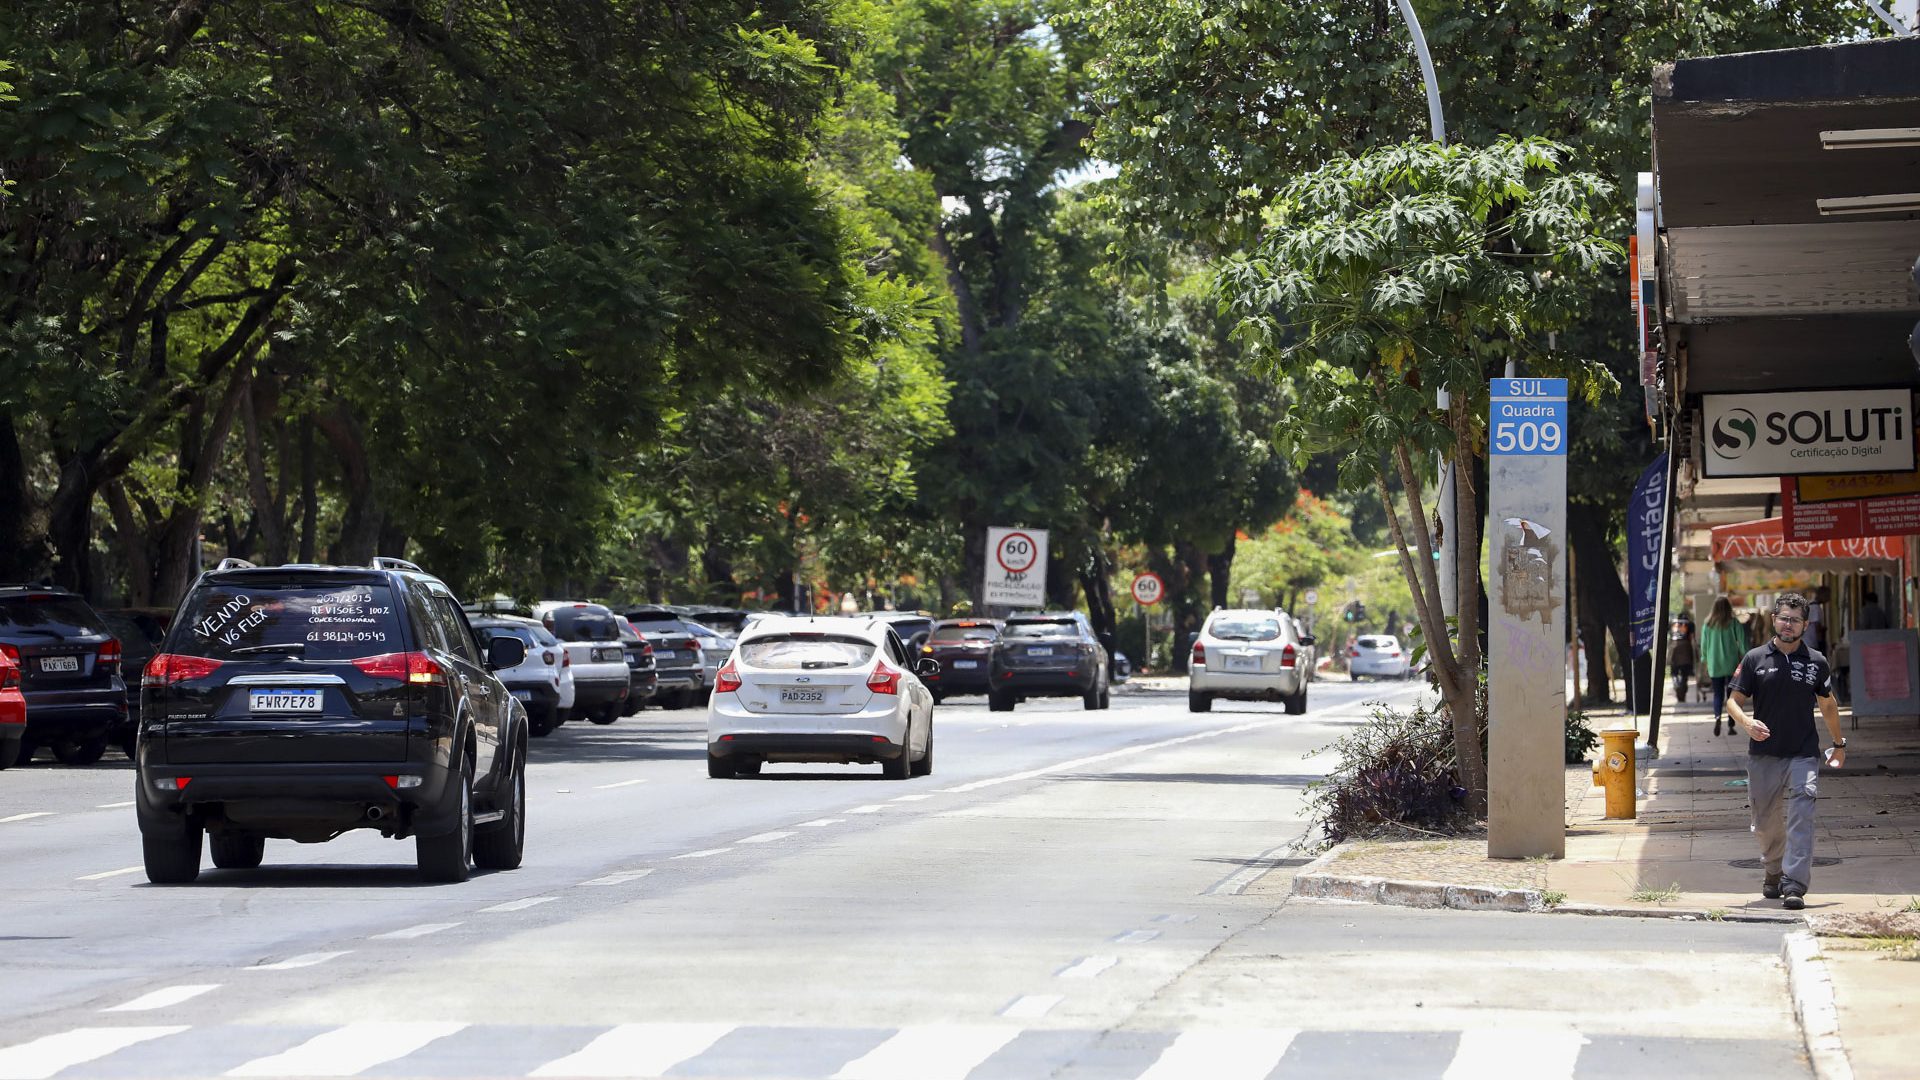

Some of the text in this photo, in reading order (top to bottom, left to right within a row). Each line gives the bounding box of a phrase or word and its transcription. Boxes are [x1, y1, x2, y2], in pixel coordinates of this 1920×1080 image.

[1509, 380, 1547, 396] SUL
[1501, 404, 1555, 417] Quadra
[1495, 422, 1561, 452] 509
[1790, 446, 1882, 459] Certificação Digital
[1006, 541, 1028, 555] 60
[1138, 579, 1156, 592] 60
[193, 594, 250, 637] VENDO
[219, 608, 268, 646] V6 FLEX
[306, 631, 319, 641] 61
[256, 696, 316, 710] FWR7E78
